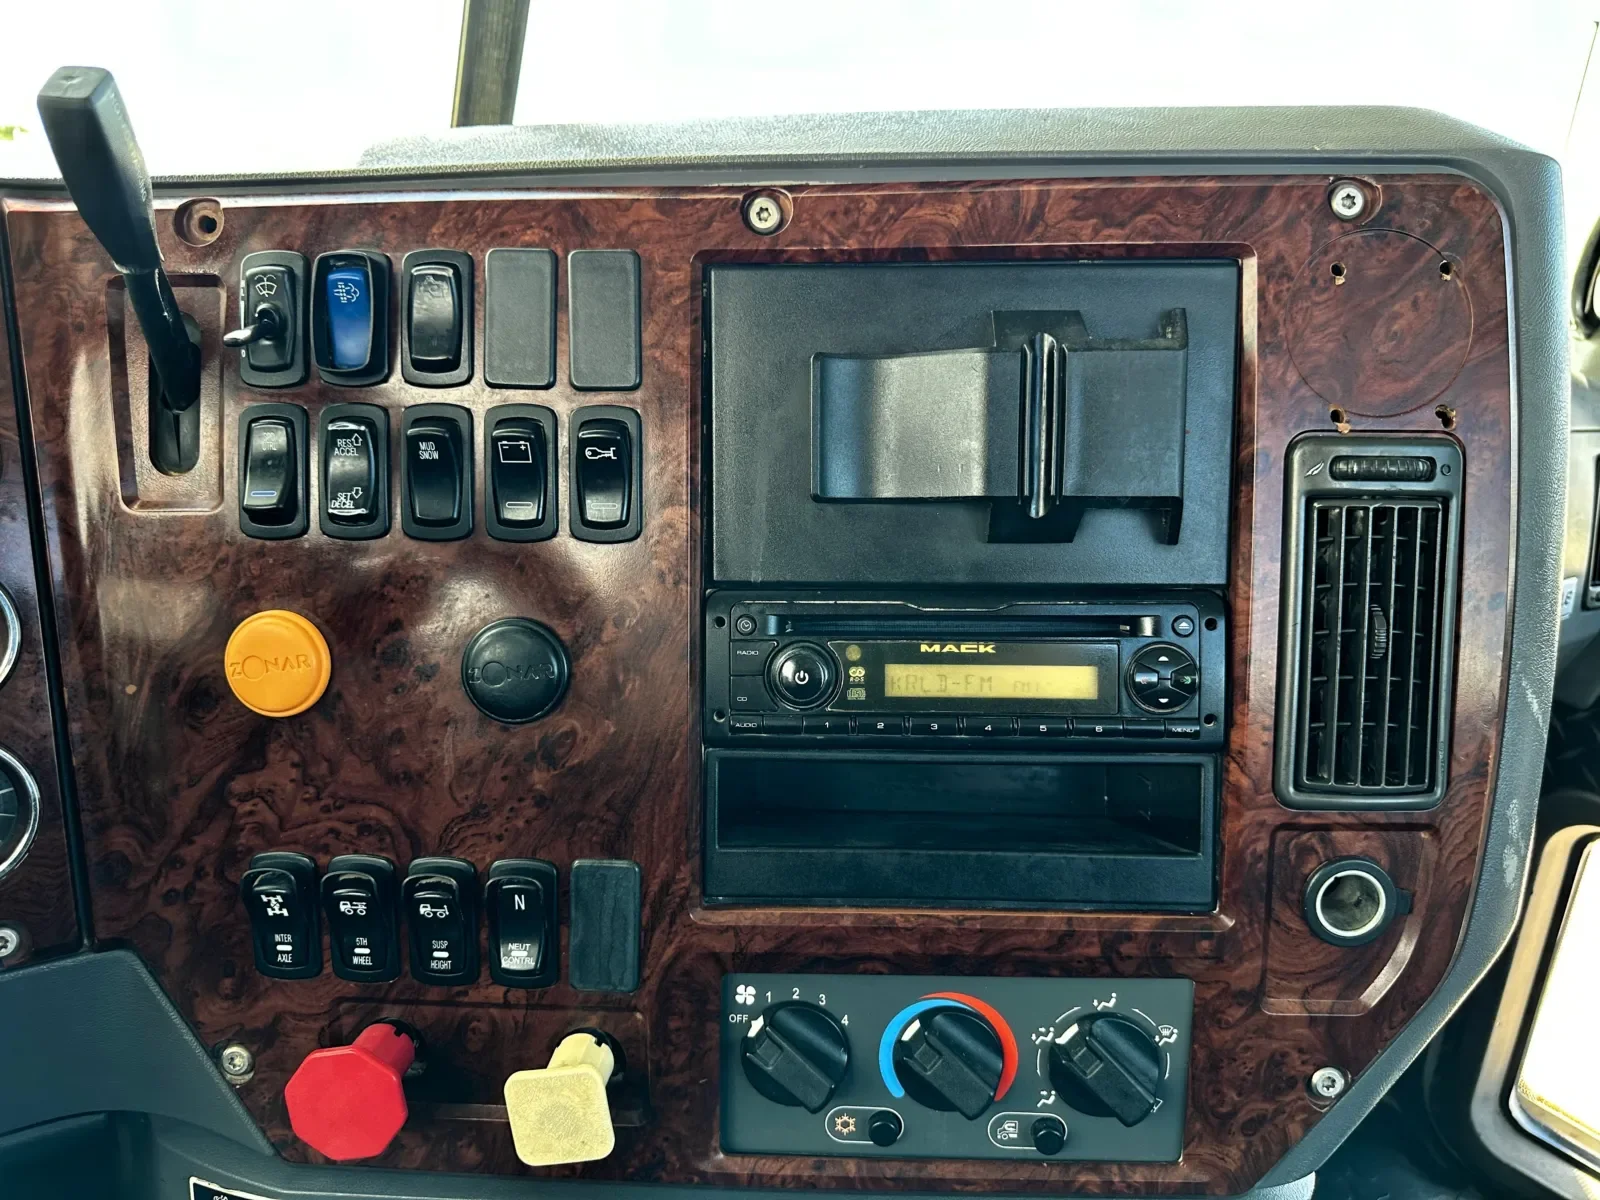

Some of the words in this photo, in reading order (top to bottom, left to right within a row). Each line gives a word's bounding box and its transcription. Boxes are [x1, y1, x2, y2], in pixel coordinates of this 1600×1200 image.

[418, 441, 436, 451] MUD
[334, 447, 359, 456] ACCEL
[418, 450, 439, 460] SNOW
[337, 492, 352, 501] SET
[331, 500, 355, 508] DECEL
[920, 643, 996, 653] MACK
[229, 654, 311, 681] ZONAR
[468, 661, 555, 688] ZONAR
[824, 721, 830, 729] 1
[984, 724, 992, 732] 4
[1039, 724, 1047, 732] 5
[1095, 725, 1103, 733] 6
[514, 894, 526, 911] N
[274, 933, 293, 943] INTER
[355, 937, 368, 946] 5TH
[432, 940, 449, 949] SUSP
[508, 943, 531, 951] NEUT
[277, 953, 293, 963] AXLE
[352, 955, 373, 965] WHEEL
[502, 956, 535, 965] CONTRL
[430, 959, 452, 970] HEIGHT
[765, 991, 772, 1003] 1
[792, 987, 800, 999] 2
[818, 994, 826, 1005] 3
[728, 1014, 749, 1023] OFF
[841, 1014, 849, 1026] 4
